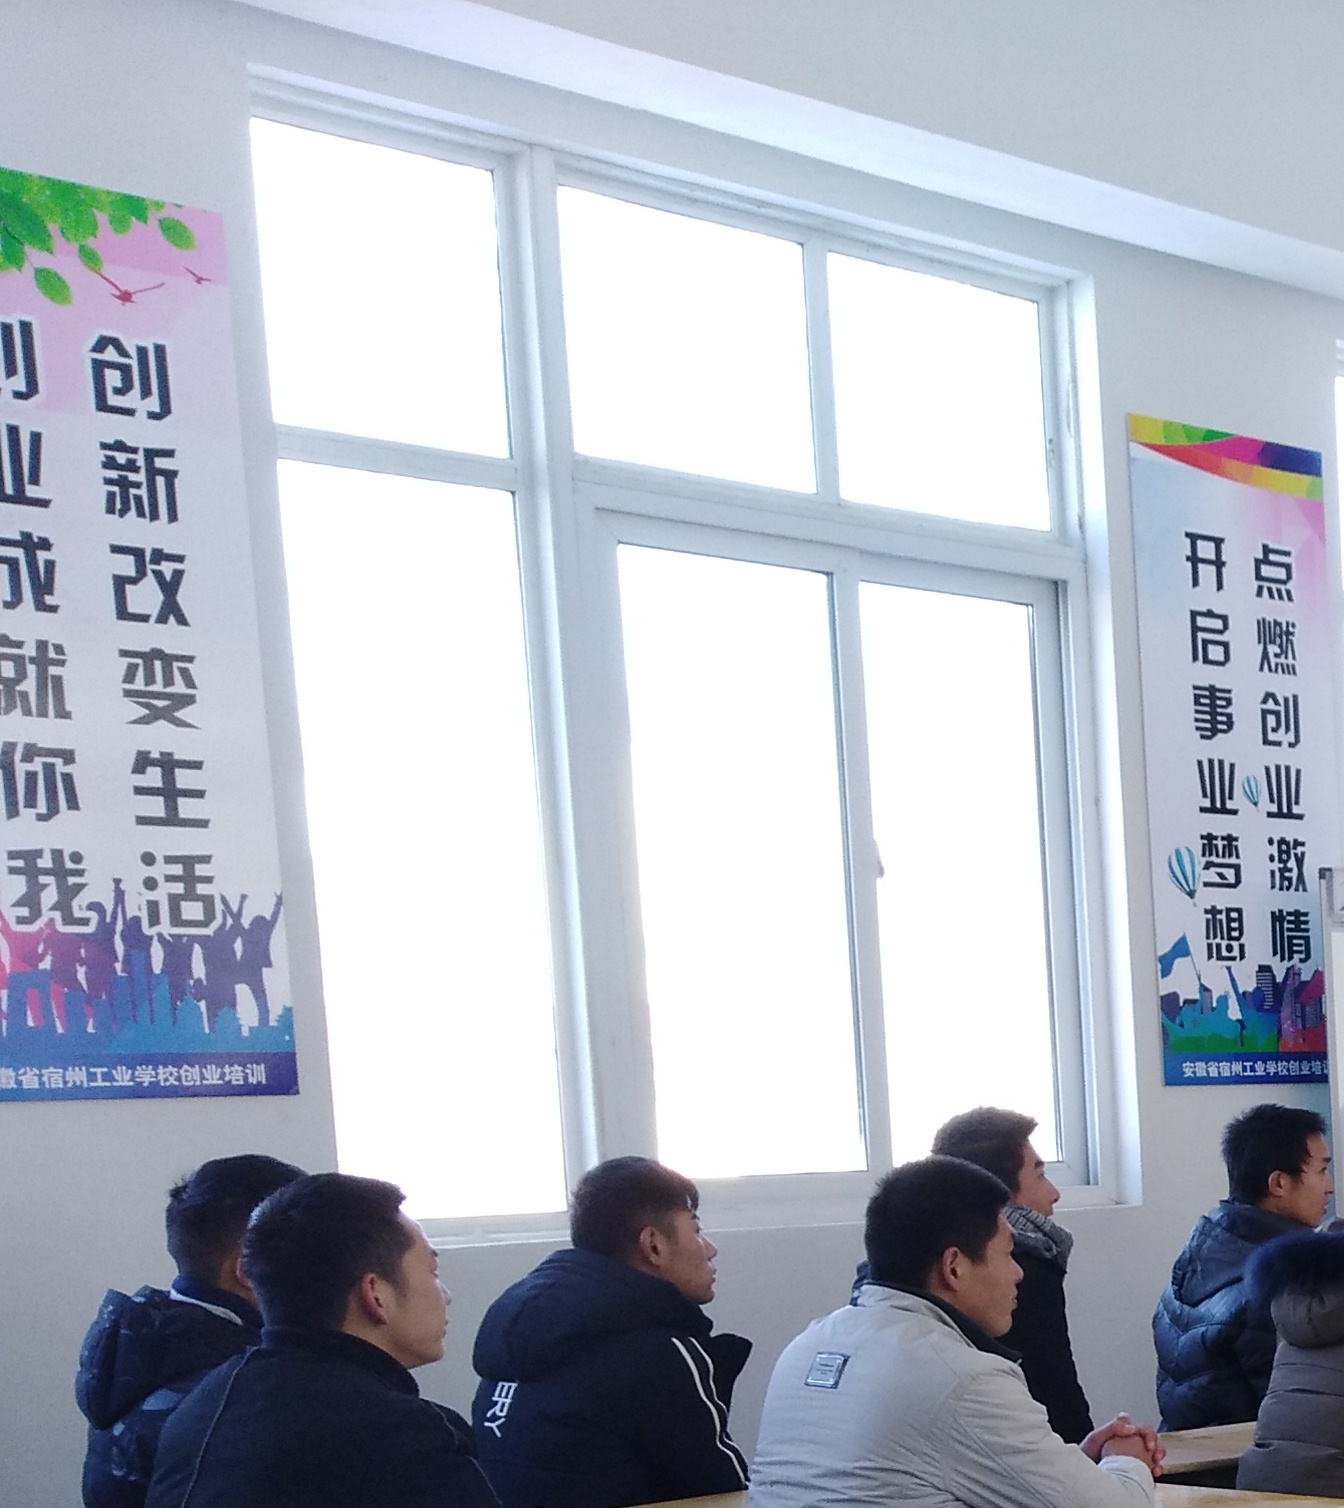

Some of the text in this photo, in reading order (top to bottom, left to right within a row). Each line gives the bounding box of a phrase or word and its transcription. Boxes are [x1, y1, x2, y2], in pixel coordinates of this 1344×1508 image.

[88, 333, 218, 930] 创新改变生活
[1184, 530, 1247, 963] 开启事业梦想
[1253, 544, 1312, 964] 点燃创业激情
